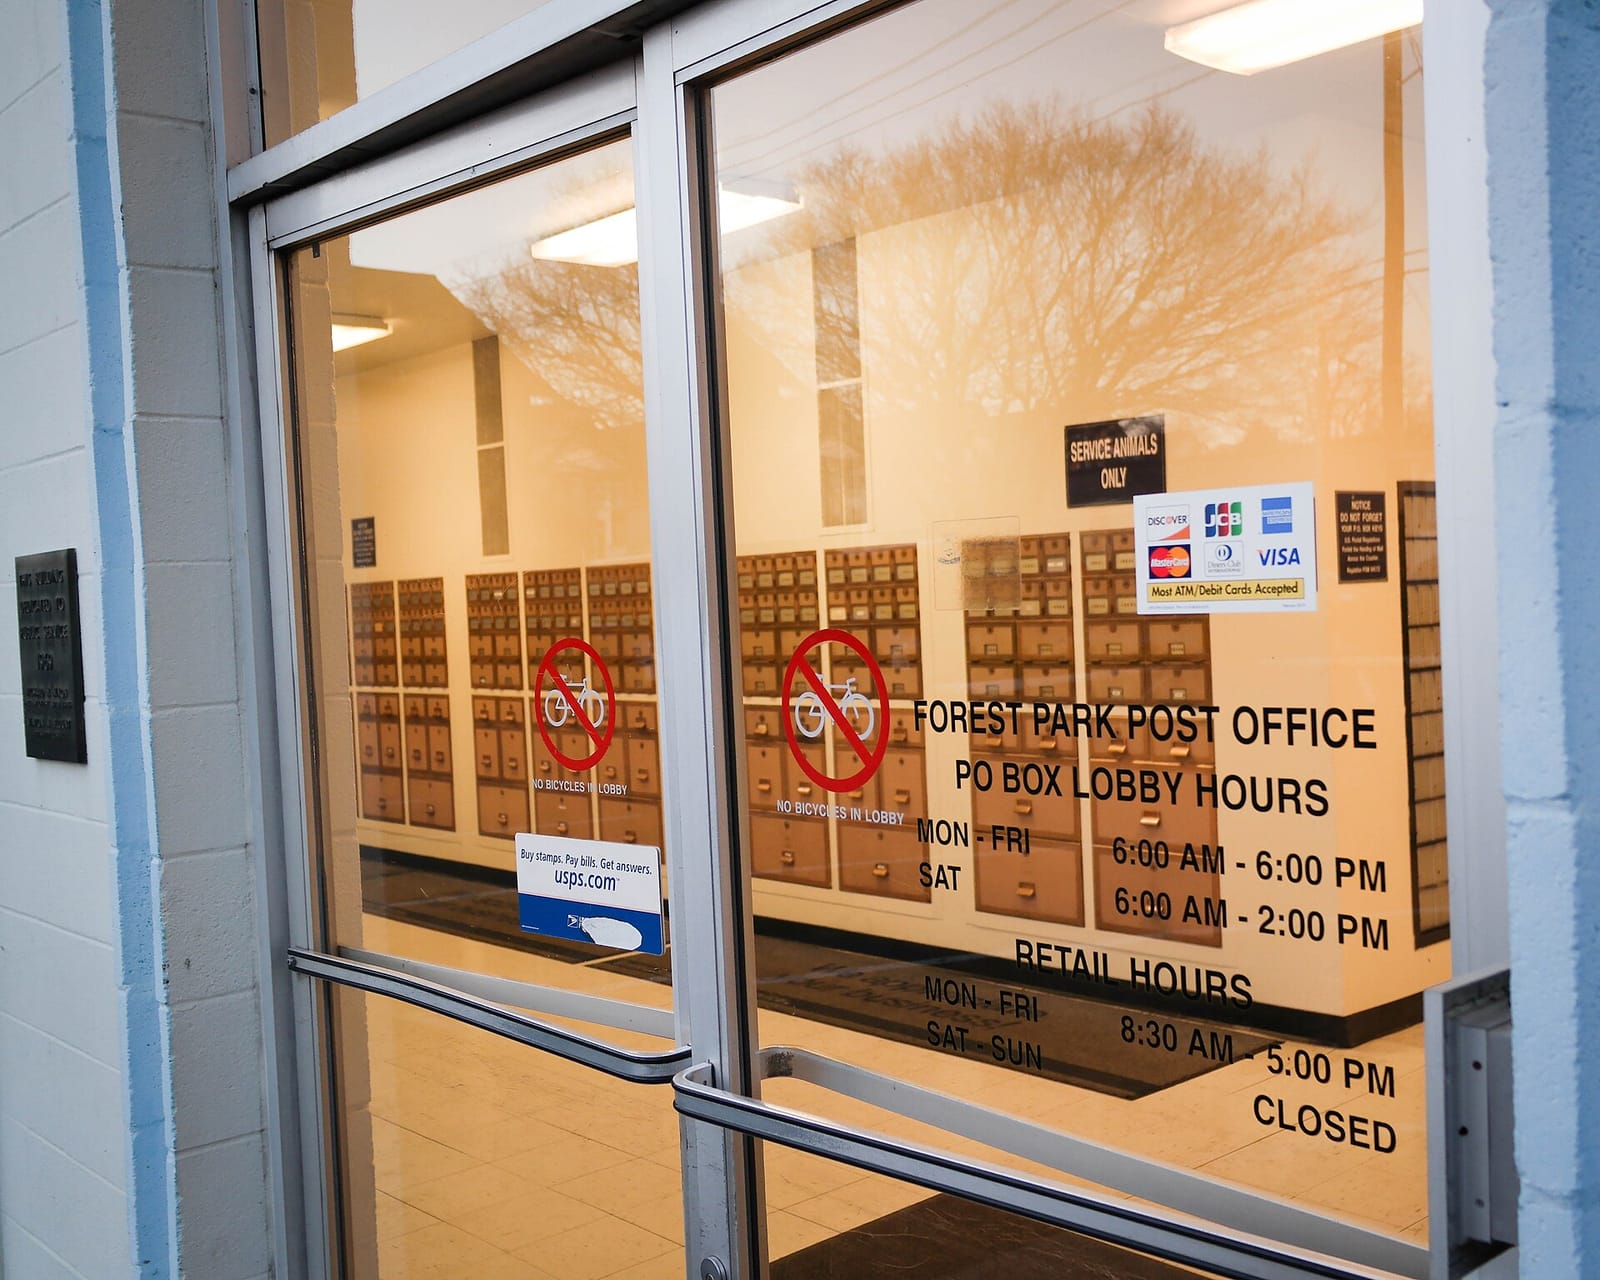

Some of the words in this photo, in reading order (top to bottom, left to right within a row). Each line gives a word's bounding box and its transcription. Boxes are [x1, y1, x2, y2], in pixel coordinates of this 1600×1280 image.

[1070, 437, 1112, 462] SERVICE
[1113, 433, 1158, 458] ANIMALS
[1101, 467, 1127, 489] ONLY
[1340, 512, 1349, 522] DO
[1349, 512, 1361, 522] NOT
[1362, 512, 1383, 522] FORGET
[1351, 500, 1371, 510] NOTICE
[1147, 515, 1188, 526] DISCOVER
[1256, 547, 1301, 566] VISA
[1151, 586, 1172, 597] Most
[1175, 583, 1223, 597] ATM/Debit
[1224, 583, 1252, 596] Cards
[1255, 581, 1298, 596] Accepted
[914, 700, 1022, 735] FOREST
[1033, 702, 1116, 739] PARK
[1128, 704, 1220, 743] POST
[1233, 706, 1377, 749] OFFICE
[532, 778, 544, 789] NO
[546, 780, 585, 792] BICYCLES
[599, 783, 627, 796] LOBBY
[956, 760, 993, 792] PO
[1003, 763, 1063, 797] BOX
[1073, 766, 1184, 805] LOBBY
[1196, 773, 1329, 817] HOURS
[776, 799, 792, 813] NO
[795, 801, 847, 820] BICYCLES
[850, 807, 861, 821] IN
[865, 809, 905, 825] LOBBY
[520, 848, 534, 863] Buy
[535, 851, 564, 865] stamps.
[565, 854, 579, 868] Pay
[580, 855, 598, 868] bills.
[600, 858, 614, 871] Get
[616, 861, 652, 875] answers.
[917, 818, 969, 847] MON
[992, 825, 1030, 855] FRI
[1112, 837, 1170, 869] 6:00
[1180, 842, 1226, 875] AM
[1256, 850, 1323, 886] 6:00
[1335, 857, 1387, 893] PM
[554, 869, 616, 892] usps.com
[919, 862, 961, 891] SAT
[1114, 887, 1172, 921] 6:00
[1182, 893, 1227, 929] AM
[1258, 905, 1325, 942] 2:00
[1337, 914, 1389, 951] PM
[1016, 938, 1120, 987] RETAIL
[1131, 957, 1253, 1010] HOURS
[925, 975, 977, 1009] MON
[1000, 991, 1039, 1023] FRI
[1120, 1016, 1178, 1052] 8:30
[1188, 1028, 1234, 1065] AM
[1267, 1045, 1331, 1085] 5:00
[1343, 1058, 1396, 1098] PM
[927, 1021, 969, 1054] SAT
[992, 1035, 1042, 1071] SUN
[1253, 1094, 1397, 1155] CLOSED
